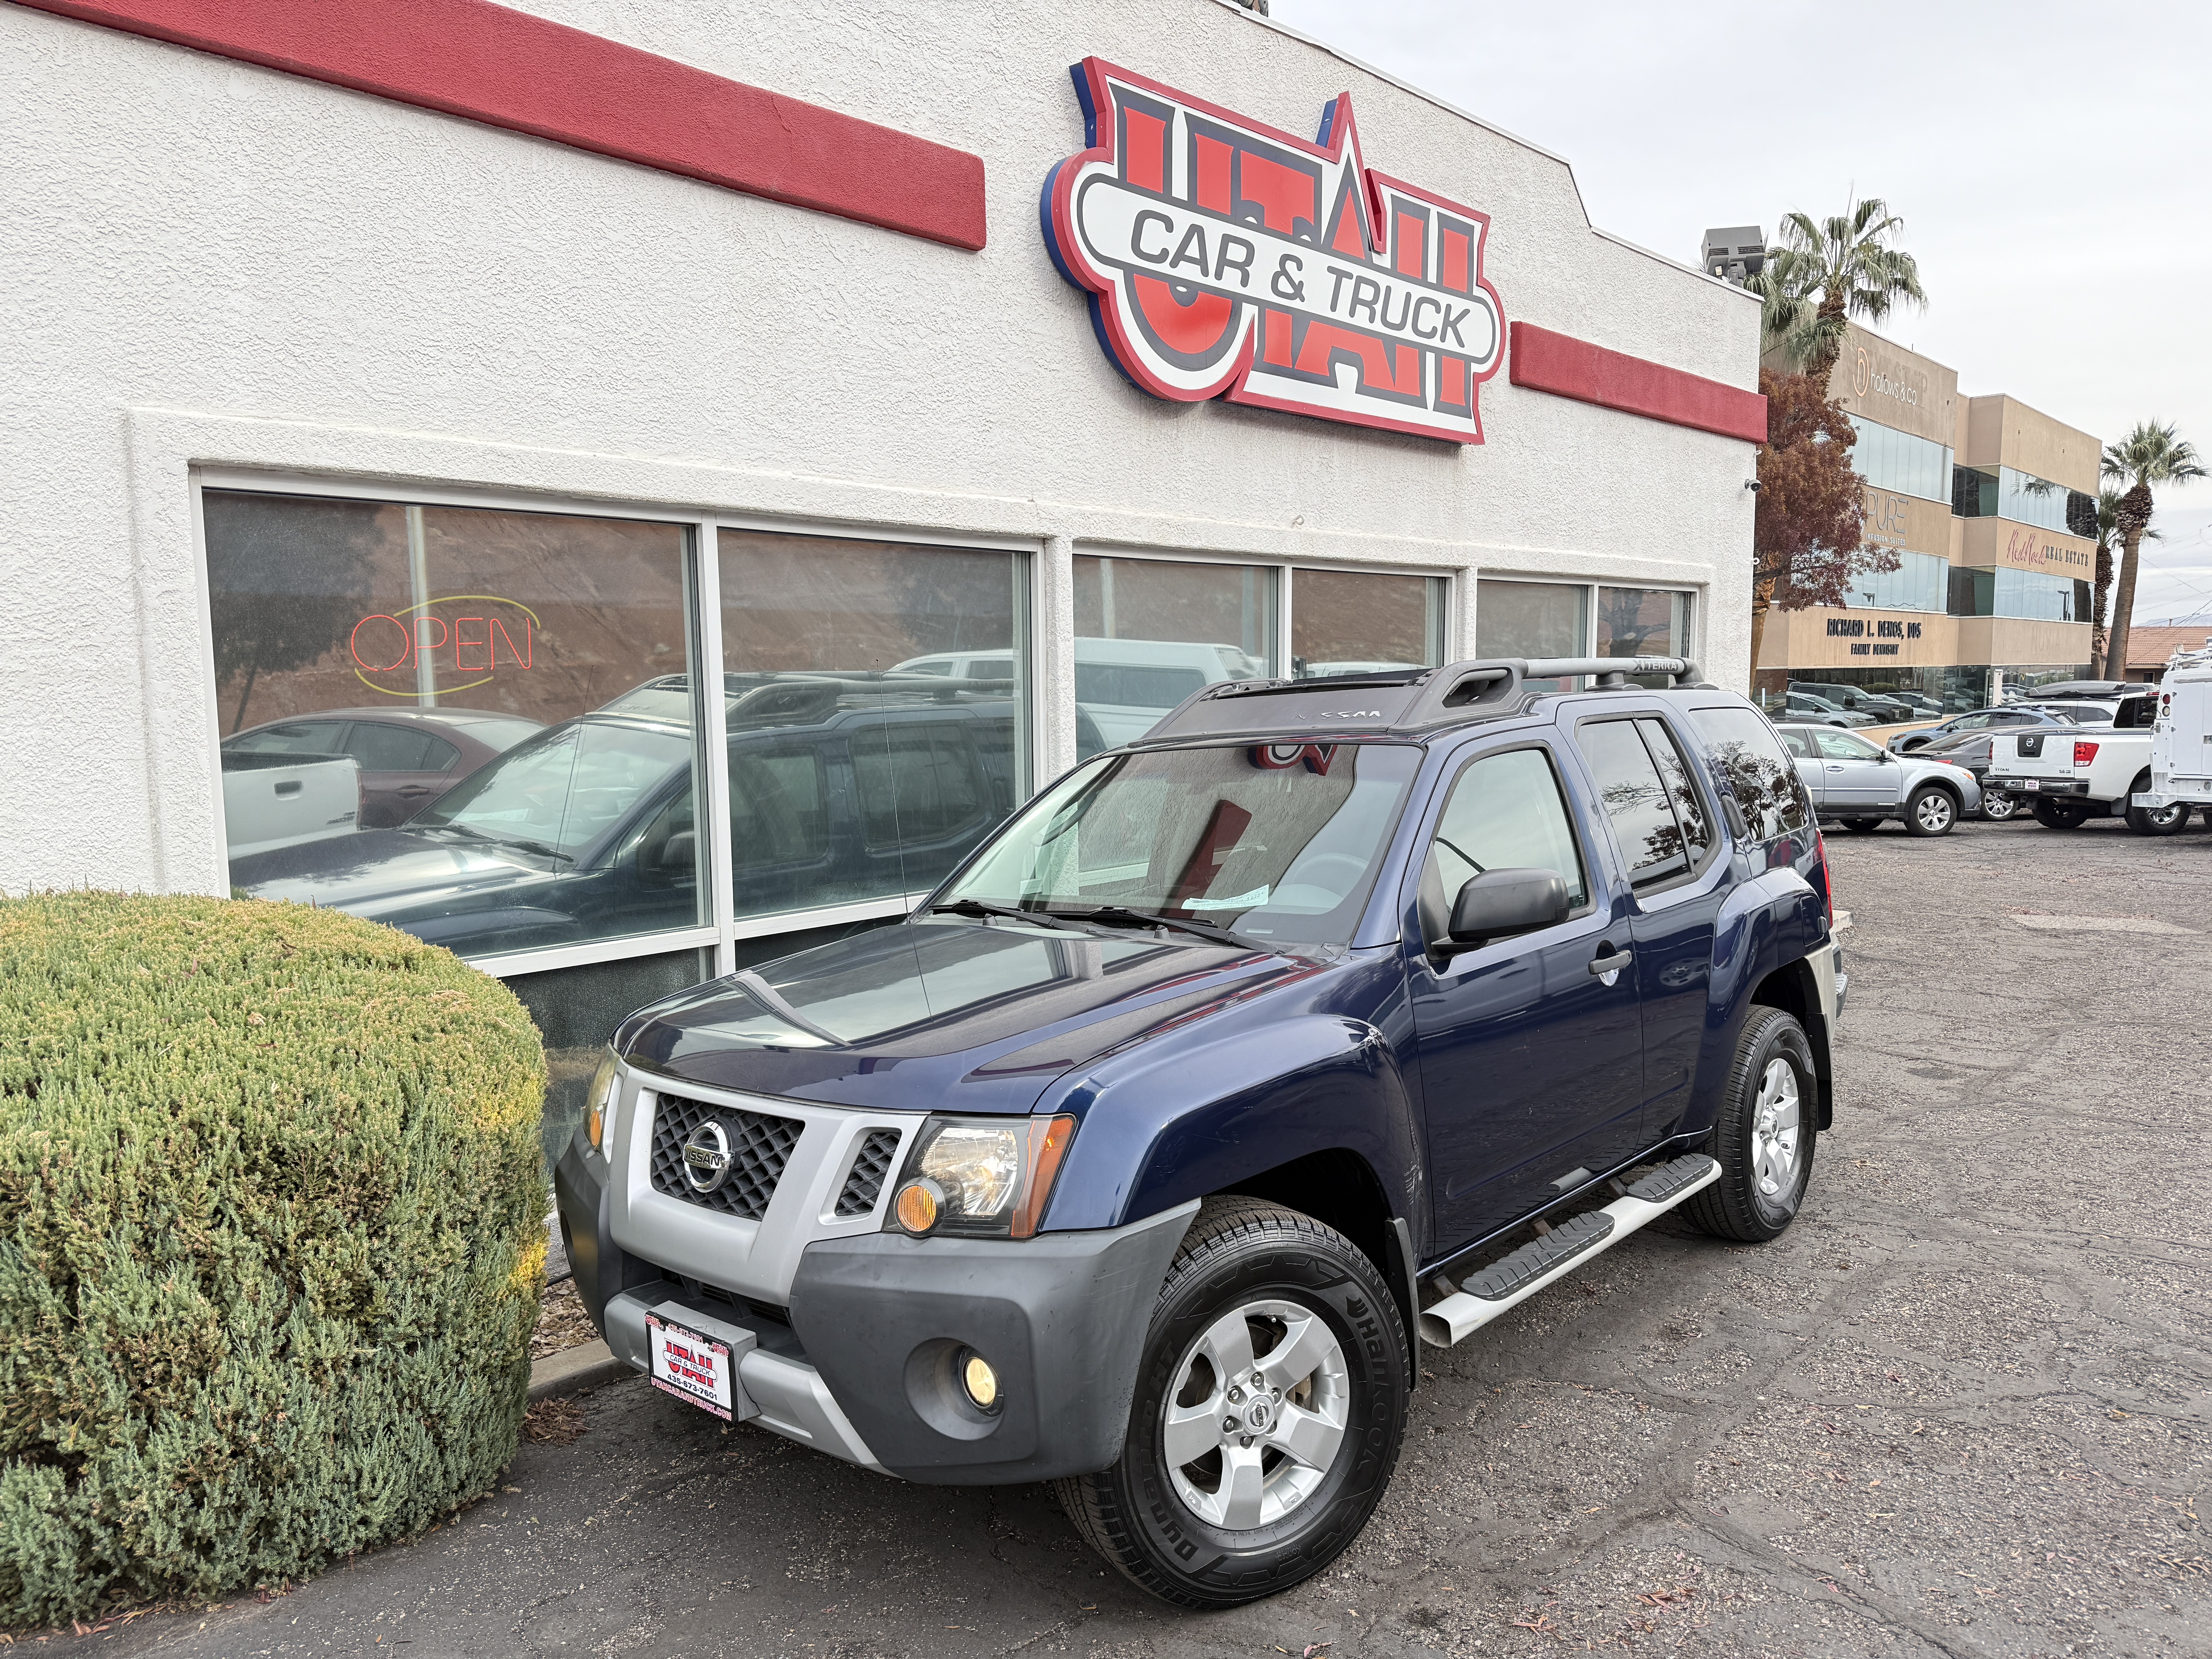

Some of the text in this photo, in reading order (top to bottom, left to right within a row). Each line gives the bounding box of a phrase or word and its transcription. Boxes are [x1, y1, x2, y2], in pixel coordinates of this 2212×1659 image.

[1109, 81, 1475, 420] UTAH
[1130, 209, 1471, 349] CAR & TRUCK
[1870, 368, 1899, 399] hallows
[1900, 381, 1906, 402] &
[1907, 387, 1917, 405] co
[1866, 490, 1906, 534] PURE
[1865, 533, 1906, 546] INFUSION SUITES
[2045, 545, 2063, 561] REAL
[2066, 550, 2088, 566] ESTATE
[1827, 618, 1922, 640] RICHARD L. DENOS, DDS
[351, 614, 532, 672] OPEN
[1851, 643, 1899, 655] FAMILY DENTISTRY
[1632, 659, 1678, 671] XTERRA
[685, 1148, 721, 1166] NISSAN
[665, 1340, 714, 1388] UTAH
[670, 1355, 682, 1365] CAR
[690, 1363, 710, 1376] TRUCK
[667, 1374, 718, 1401] 435-673-7601
